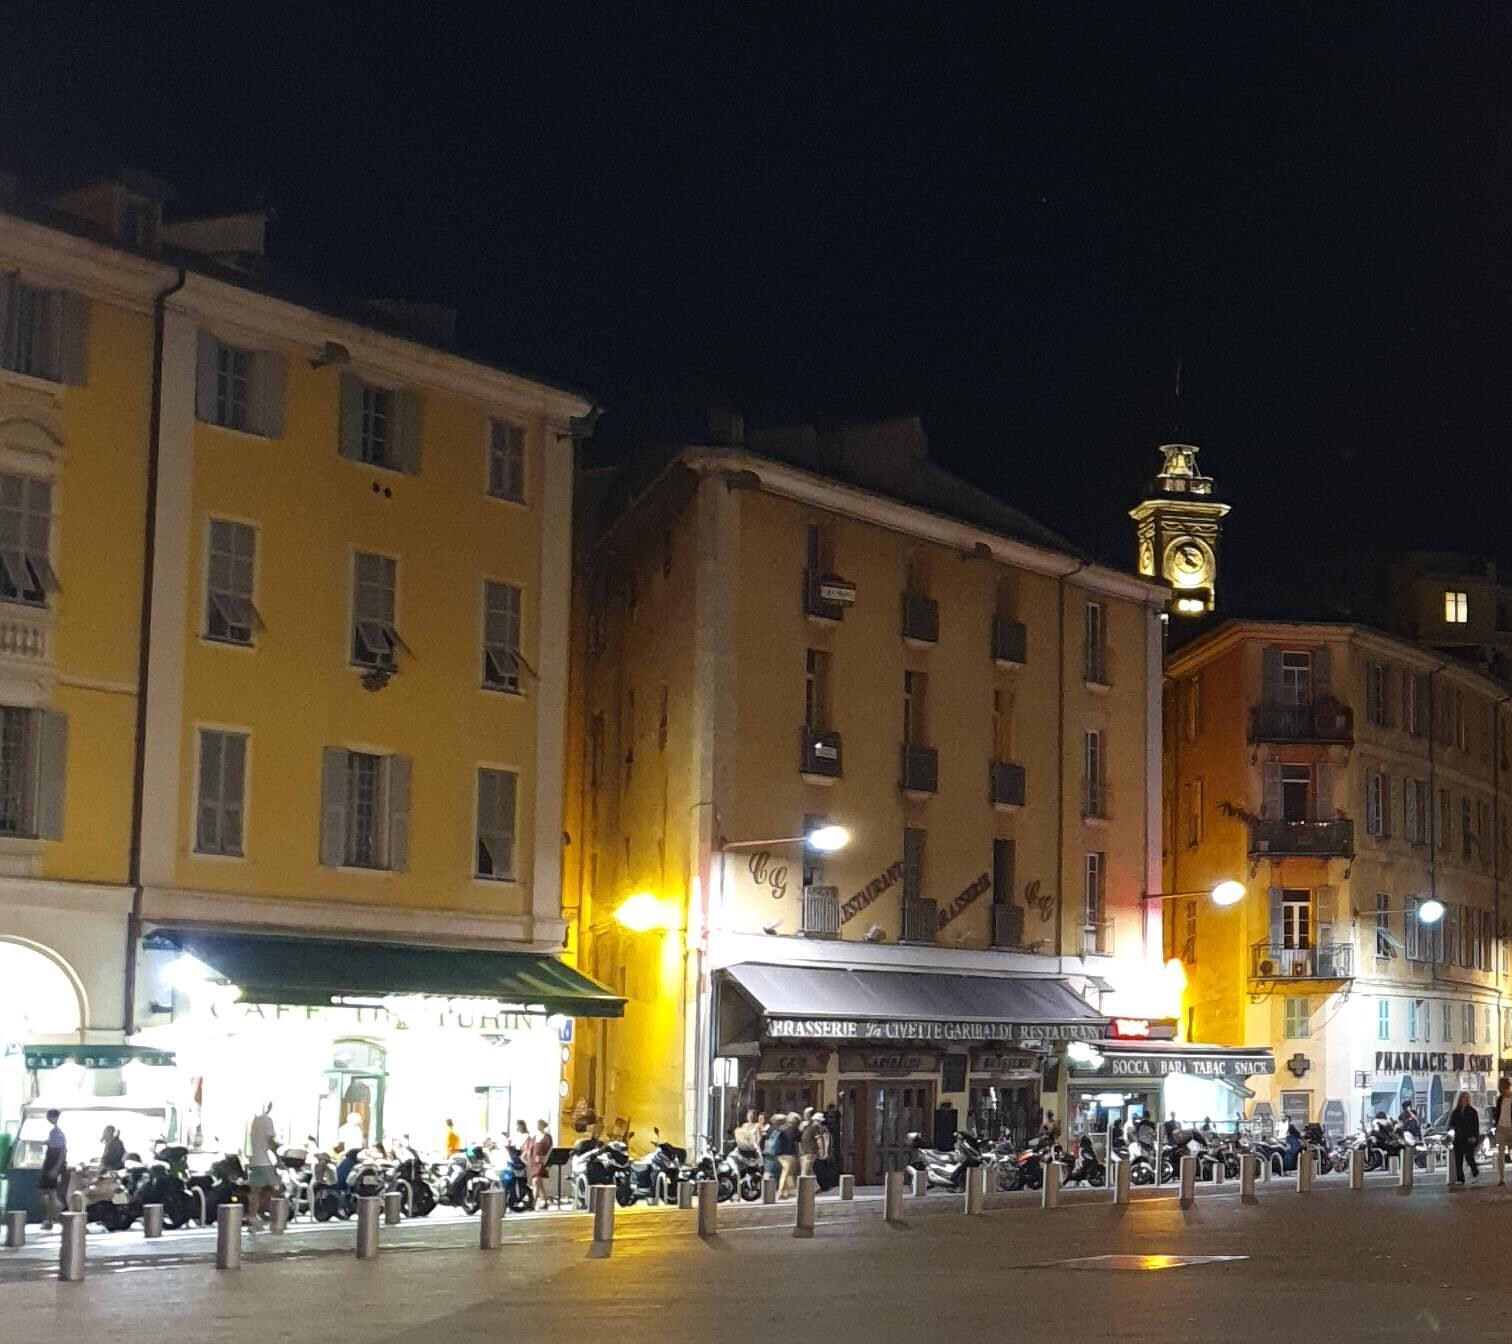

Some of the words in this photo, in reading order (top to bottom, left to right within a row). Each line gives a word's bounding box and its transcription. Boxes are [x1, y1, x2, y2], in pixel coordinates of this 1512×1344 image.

[771, 1019, 858, 1038] BRASSERIE
[886, 1022, 943, 1040] CIVETTE
[944, 1022, 1013, 1040] GARIBALDI
[1112, 1060, 1150, 1074] SOCCA
[1193, 1061, 1226, 1075] TABAC
[1235, 1061, 1267, 1074] SNACK
[1375, 1051, 1447, 1072] PHARMACIE
